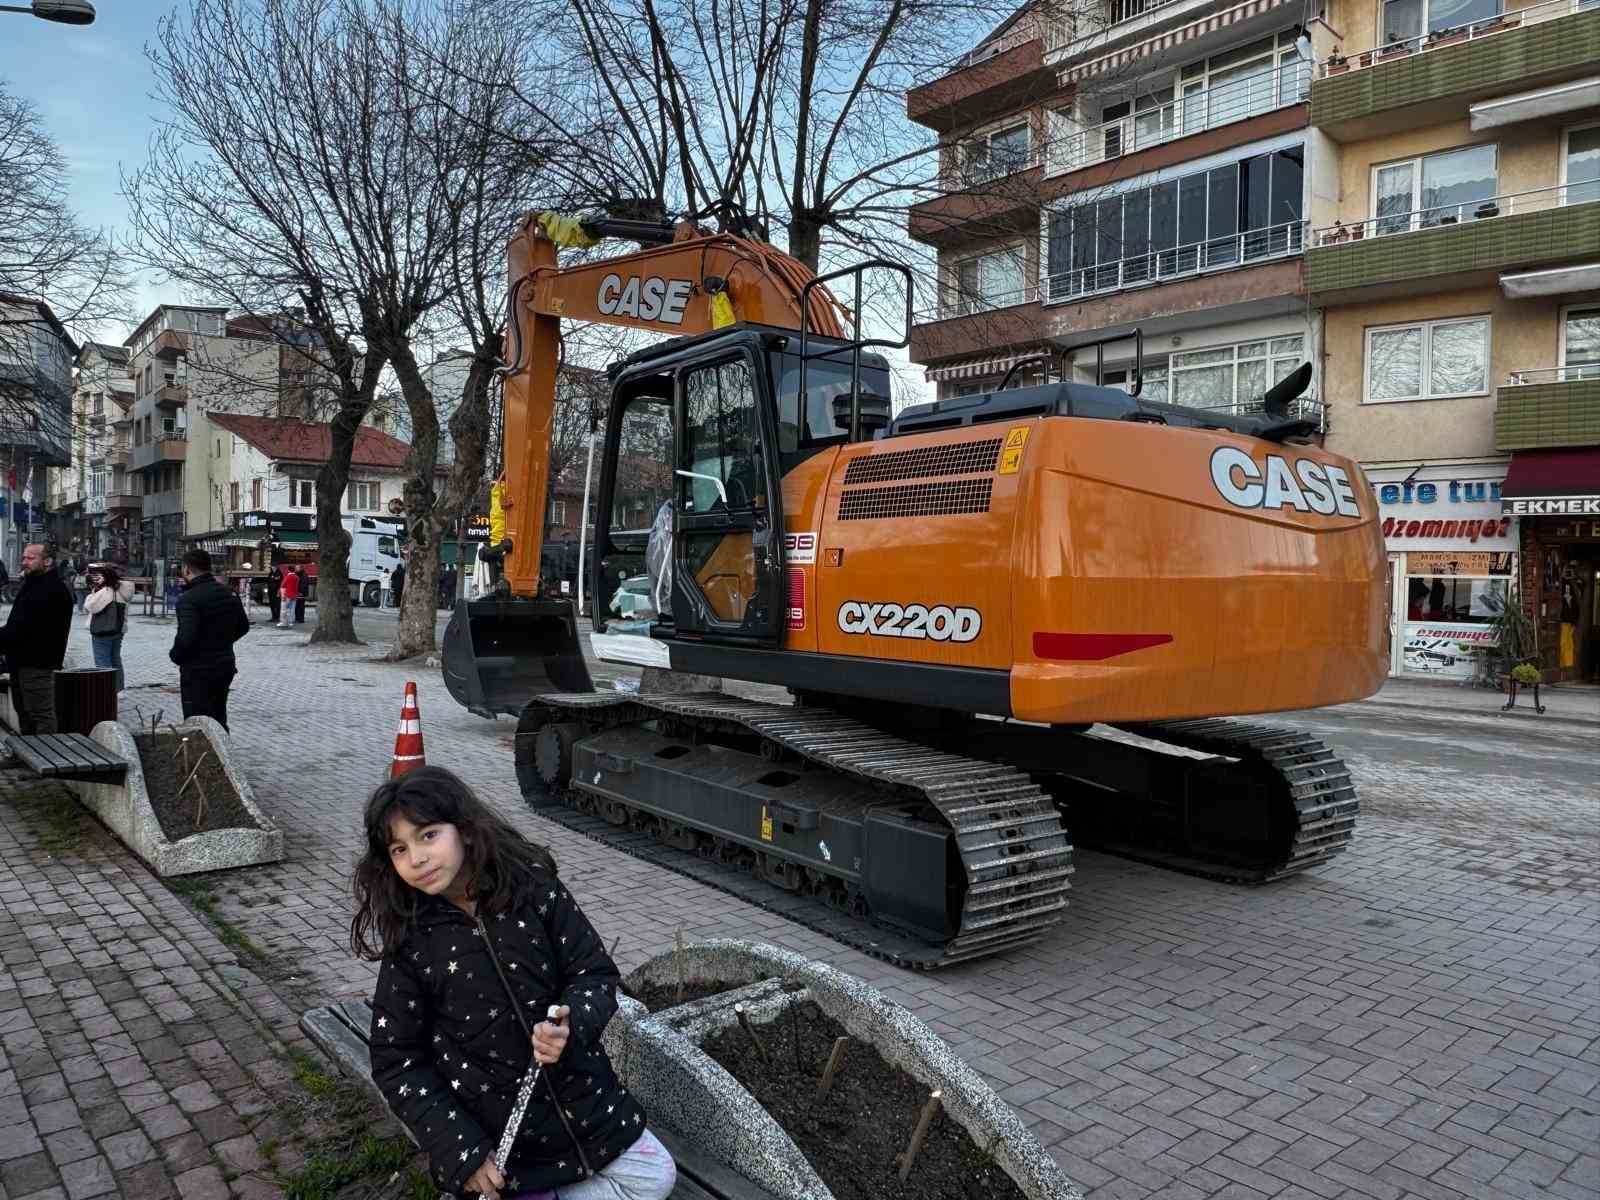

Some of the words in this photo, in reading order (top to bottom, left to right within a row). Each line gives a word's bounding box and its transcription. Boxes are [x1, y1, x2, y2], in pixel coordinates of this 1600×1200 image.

[598, 273, 692, 324] CASE
[1209, 445, 1361, 519] CASE
[838, 600, 982, 643] CX220D
